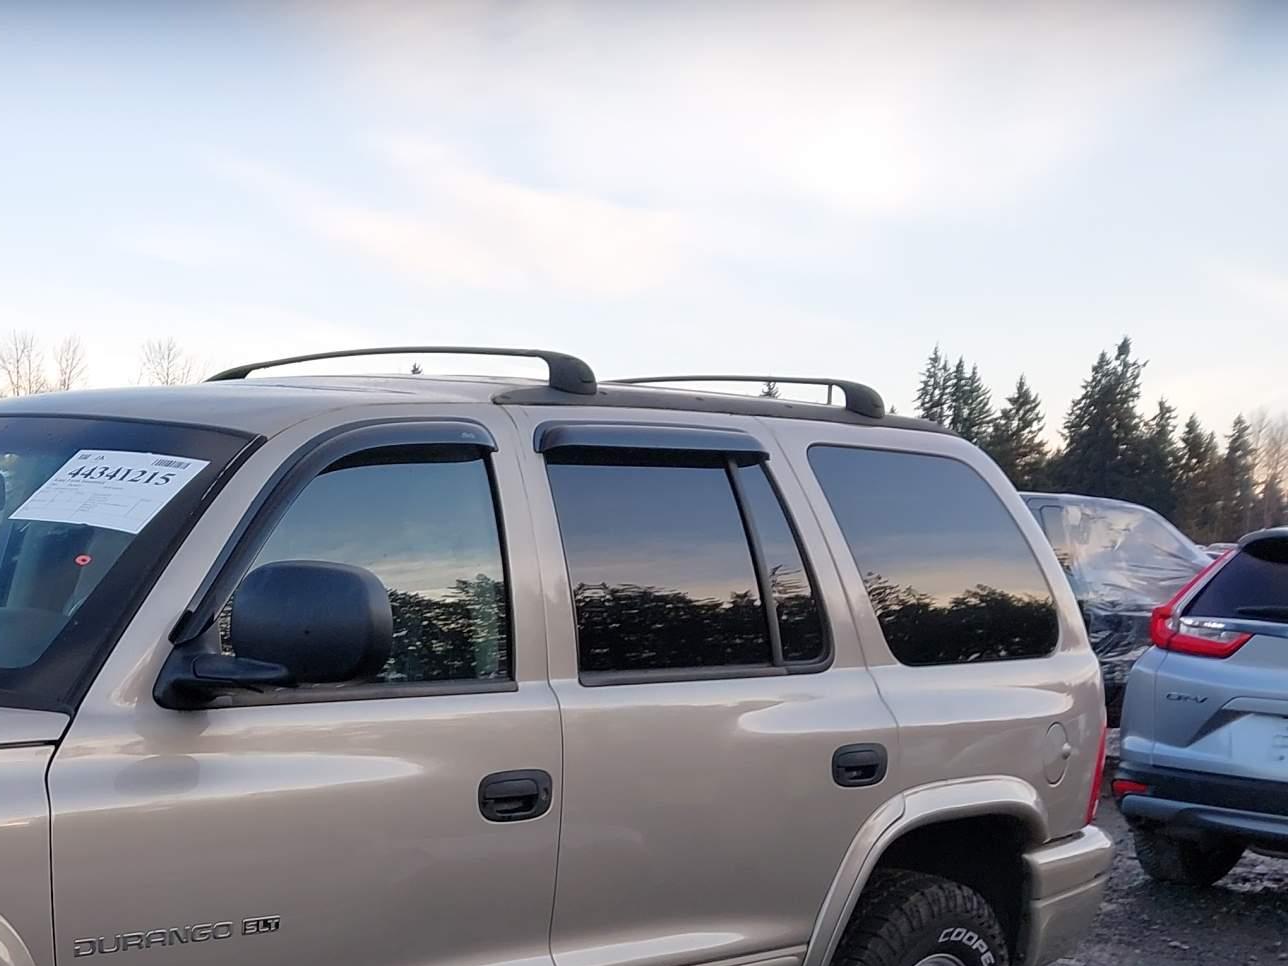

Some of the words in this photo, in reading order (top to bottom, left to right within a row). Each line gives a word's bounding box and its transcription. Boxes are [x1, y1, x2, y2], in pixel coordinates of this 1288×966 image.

[68, 465, 176, 486] 44341215
[73, 921, 233, 957] DURANGO
[242, 915, 280, 936] SLT
